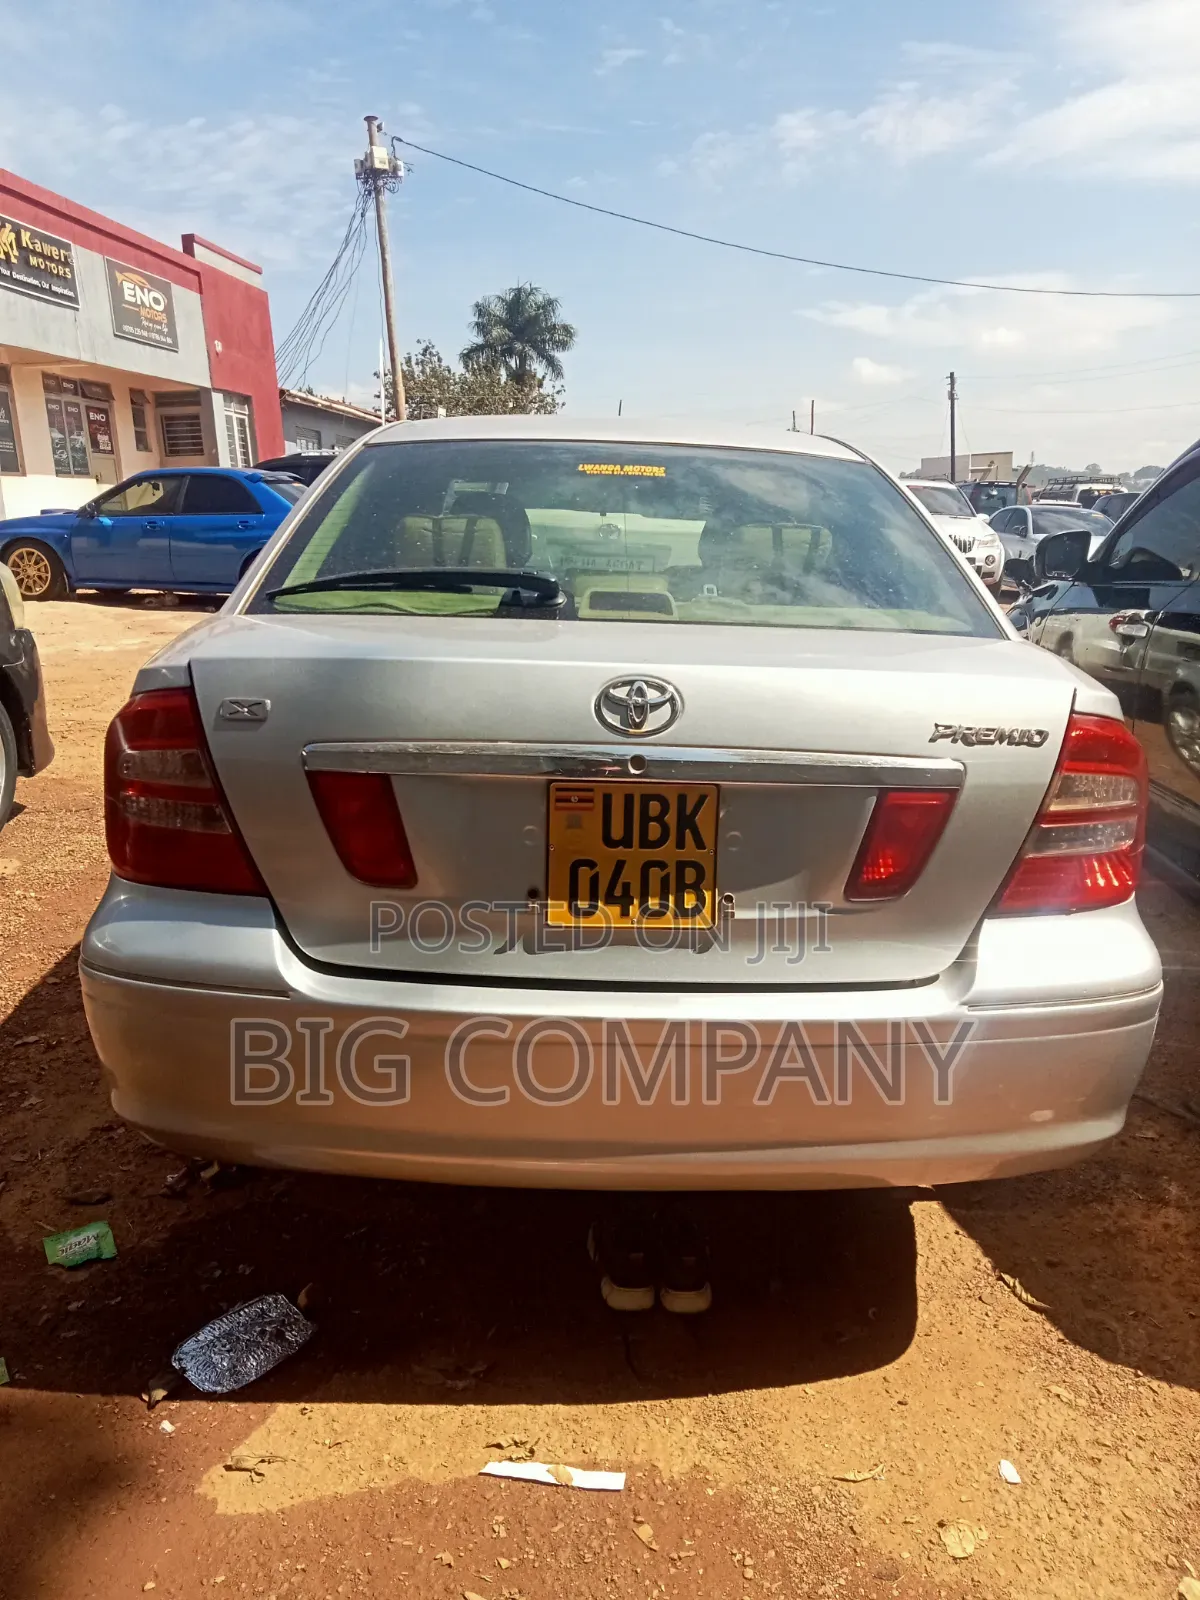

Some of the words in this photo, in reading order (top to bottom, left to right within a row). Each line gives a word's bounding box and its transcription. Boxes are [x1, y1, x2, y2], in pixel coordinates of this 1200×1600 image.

[29, 254, 72, 279] MOTORS
[122, 281, 165, 312] ENO
[140, 306, 168, 324] MOTORS
[89, 411, 106, 422] ENO
[578, 464, 621, 472] LWANGA
[623, 464, 666, 474] MOTORS
[928, 722, 1050, 748] PREMIO
[602, 793, 709, 851] UBK
[567, 858, 707, 919] 040B
